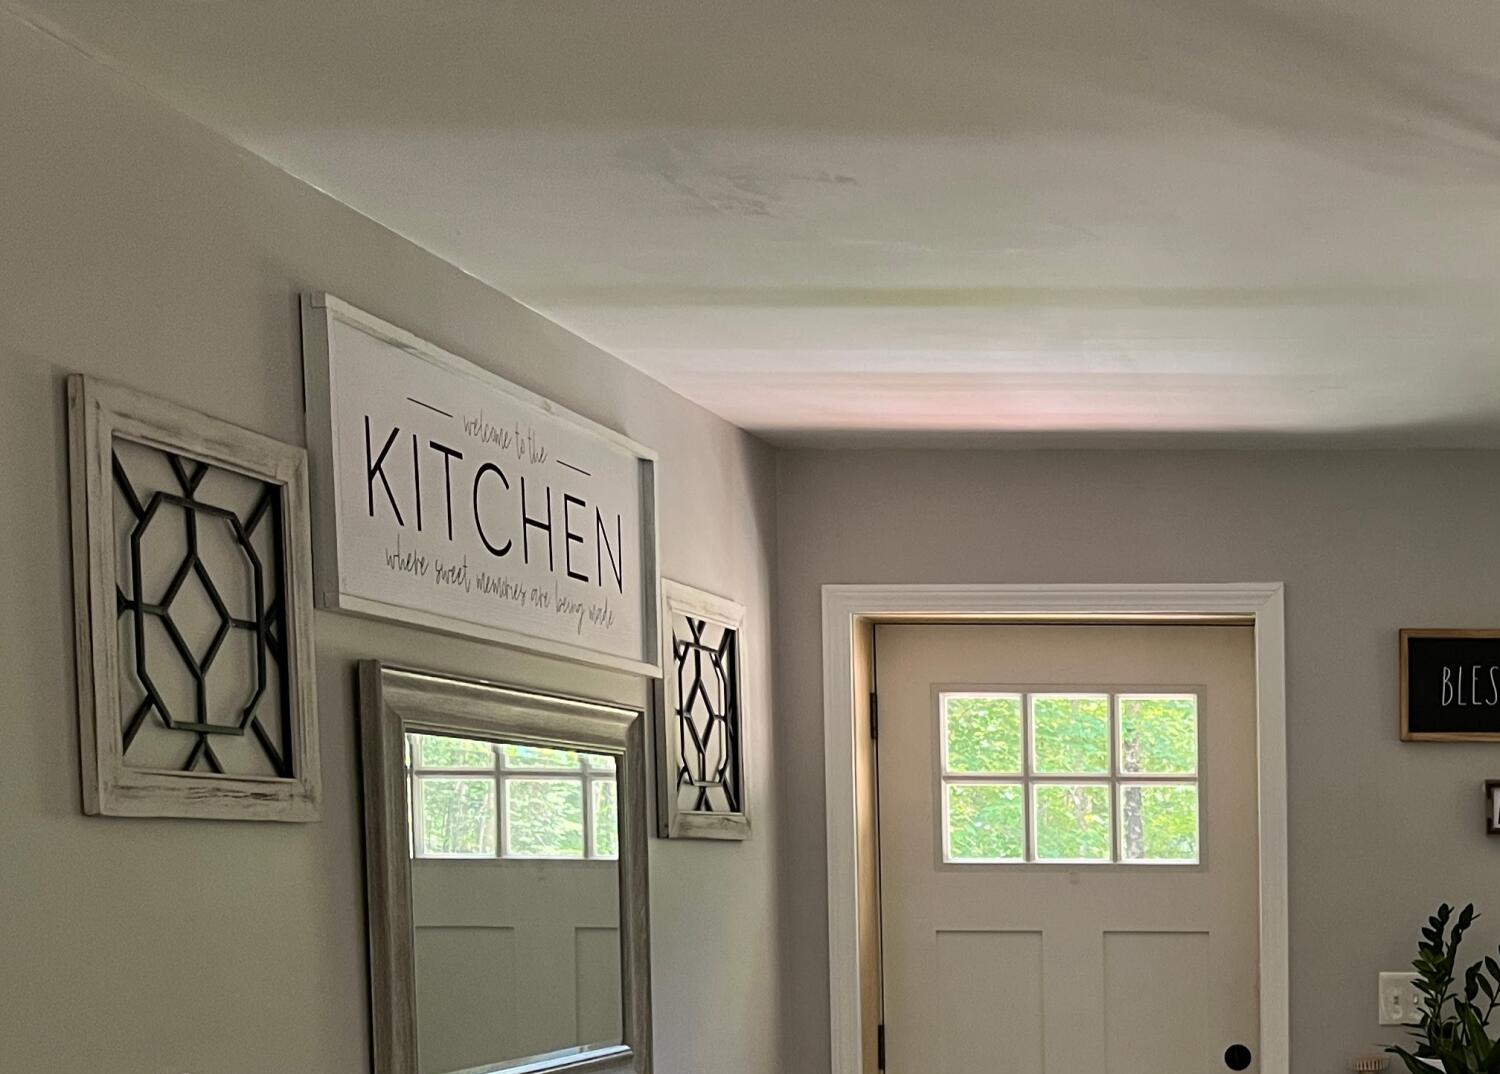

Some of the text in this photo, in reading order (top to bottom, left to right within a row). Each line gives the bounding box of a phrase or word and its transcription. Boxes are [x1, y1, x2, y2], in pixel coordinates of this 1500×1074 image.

[463, 408, 548, 464] welcome to the
[364, 415, 624, 594] KITCHEN
[385, 534, 428, 577] where
[434, 555, 471, 594] sweet
[476, 572, 527, 606] memories
[530, 588, 549, 609] are
[555, 580, 584, 635] being
